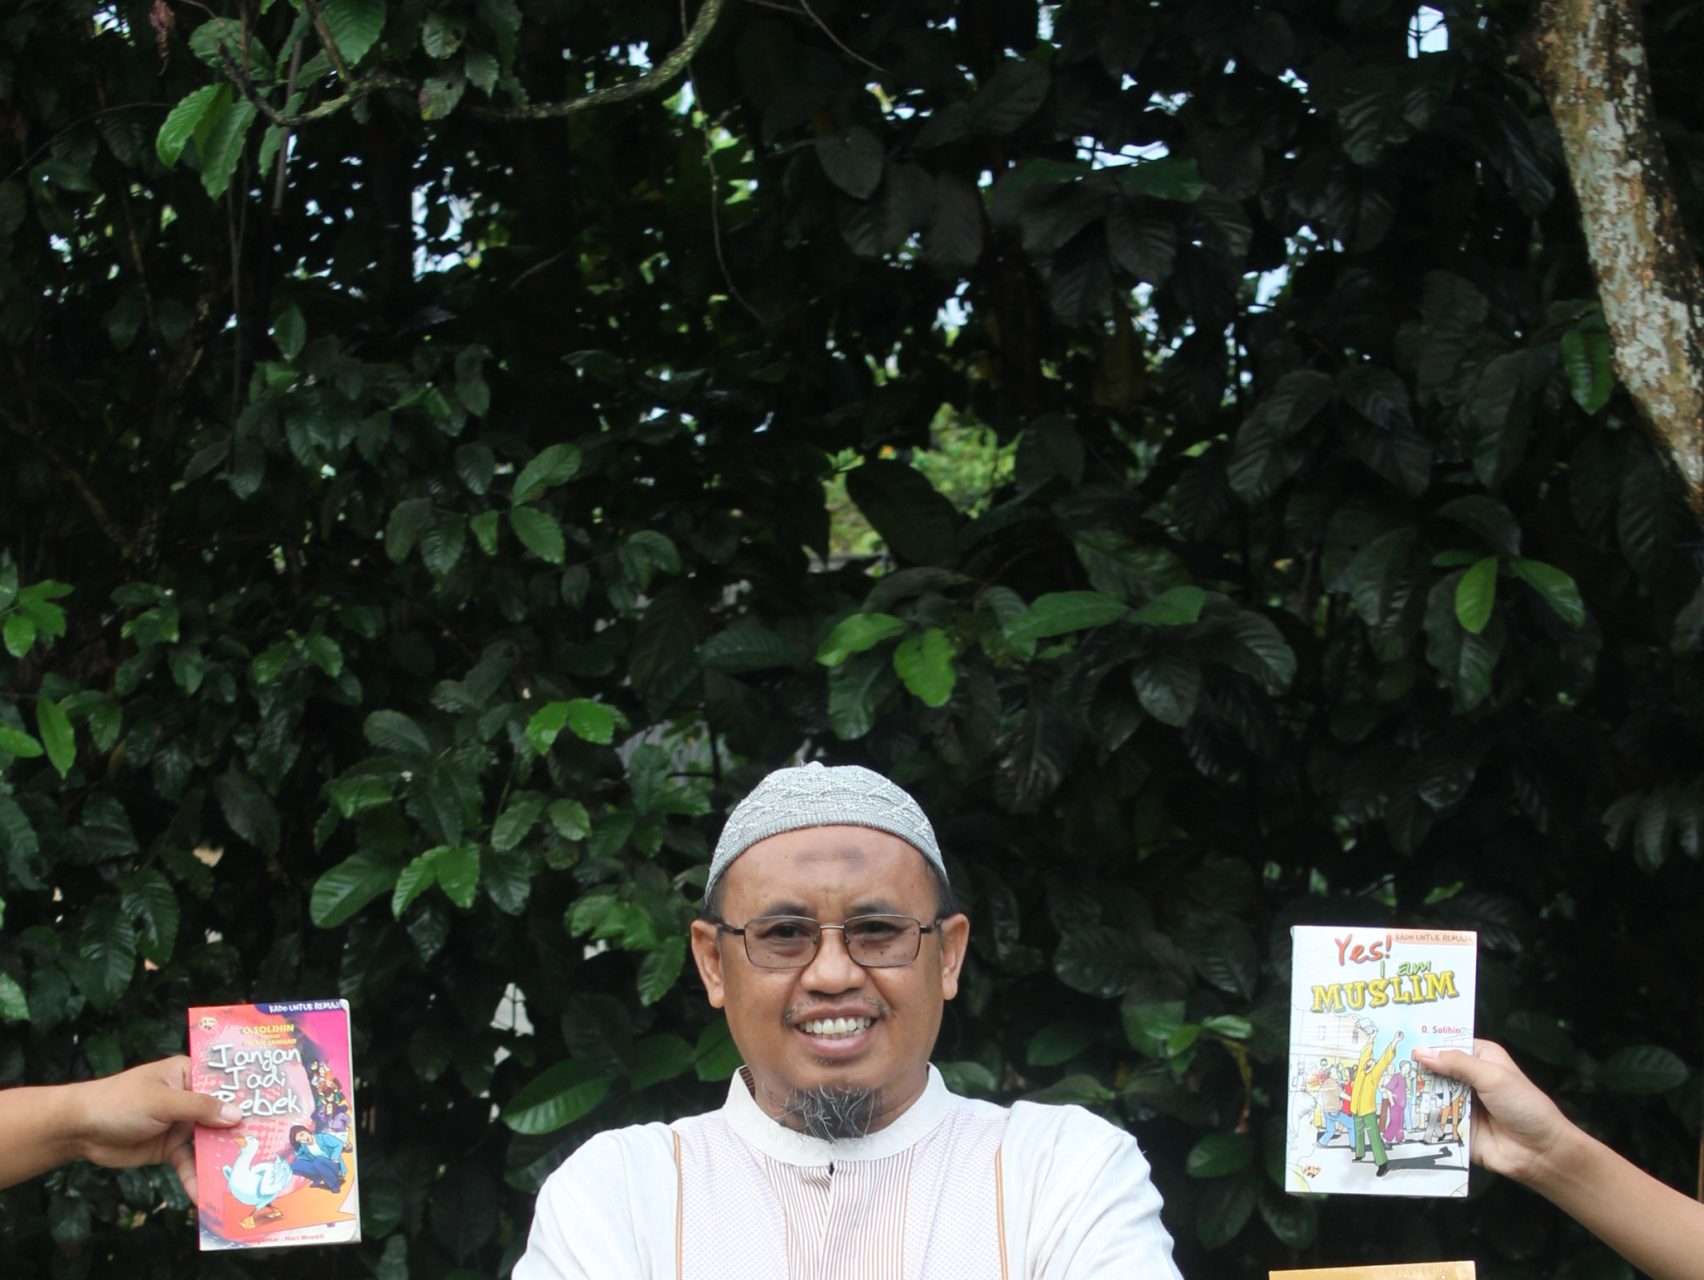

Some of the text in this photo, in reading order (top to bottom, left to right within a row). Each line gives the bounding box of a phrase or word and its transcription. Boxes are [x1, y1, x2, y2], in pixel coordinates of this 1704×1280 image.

[1334, 933, 1392, 967] Yes!
[1397, 960, 1432, 977] am
[314, 1001, 346, 1010] REMAJ
[1310, 970, 1460, 1014] MUSLIM
[1432, 1025, 1461, 1034] Solihin
[208, 1043, 302, 1072] Jangan
[220, 1064, 286, 1091] Jadi
